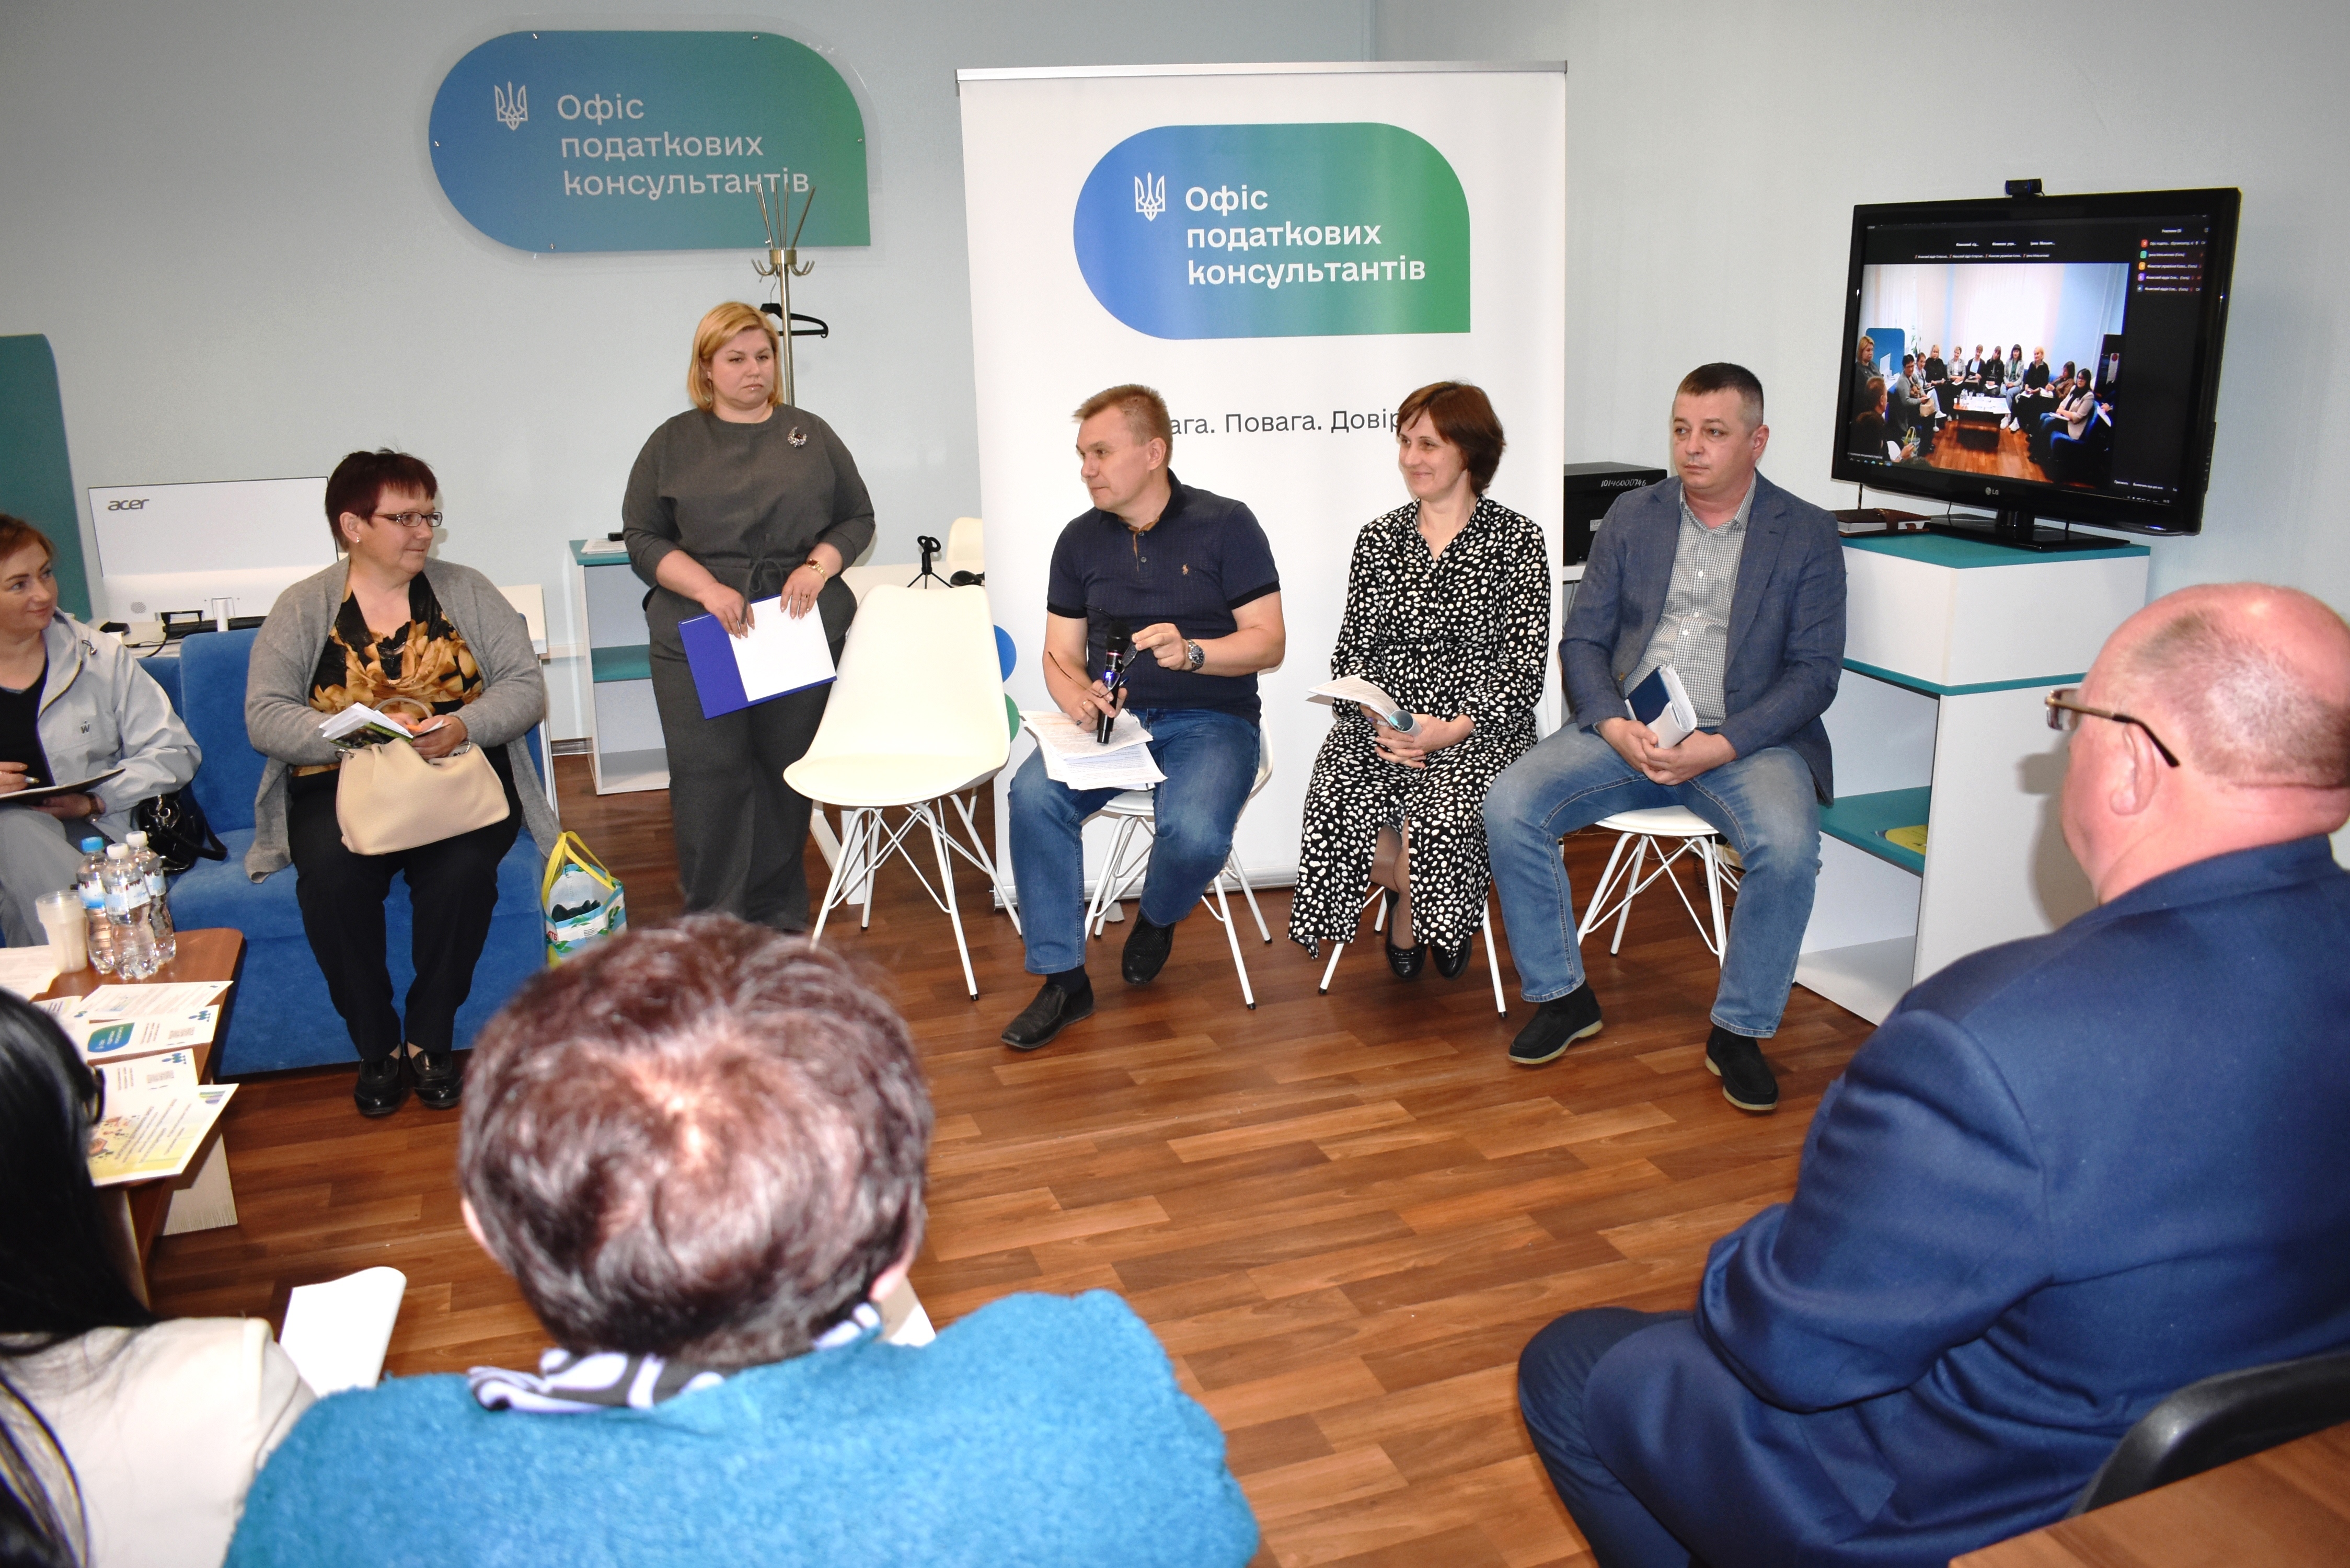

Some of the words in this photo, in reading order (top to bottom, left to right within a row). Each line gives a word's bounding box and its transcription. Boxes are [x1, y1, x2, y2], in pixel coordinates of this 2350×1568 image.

[557, 94, 644, 125] Офіс
[561, 132, 764, 161] податкових
[564, 167, 809, 200] консультантів
[1185, 185, 1268, 216] Офіс
[1187, 221, 1381, 250] податкових
[1188, 255, 1426, 289] консультантів
[1171, 419, 1215, 434] ага.
[1226, 413, 1322, 433] Повага.
[1331, 408, 1399, 433] Довір
[108, 499, 149, 511] acer
